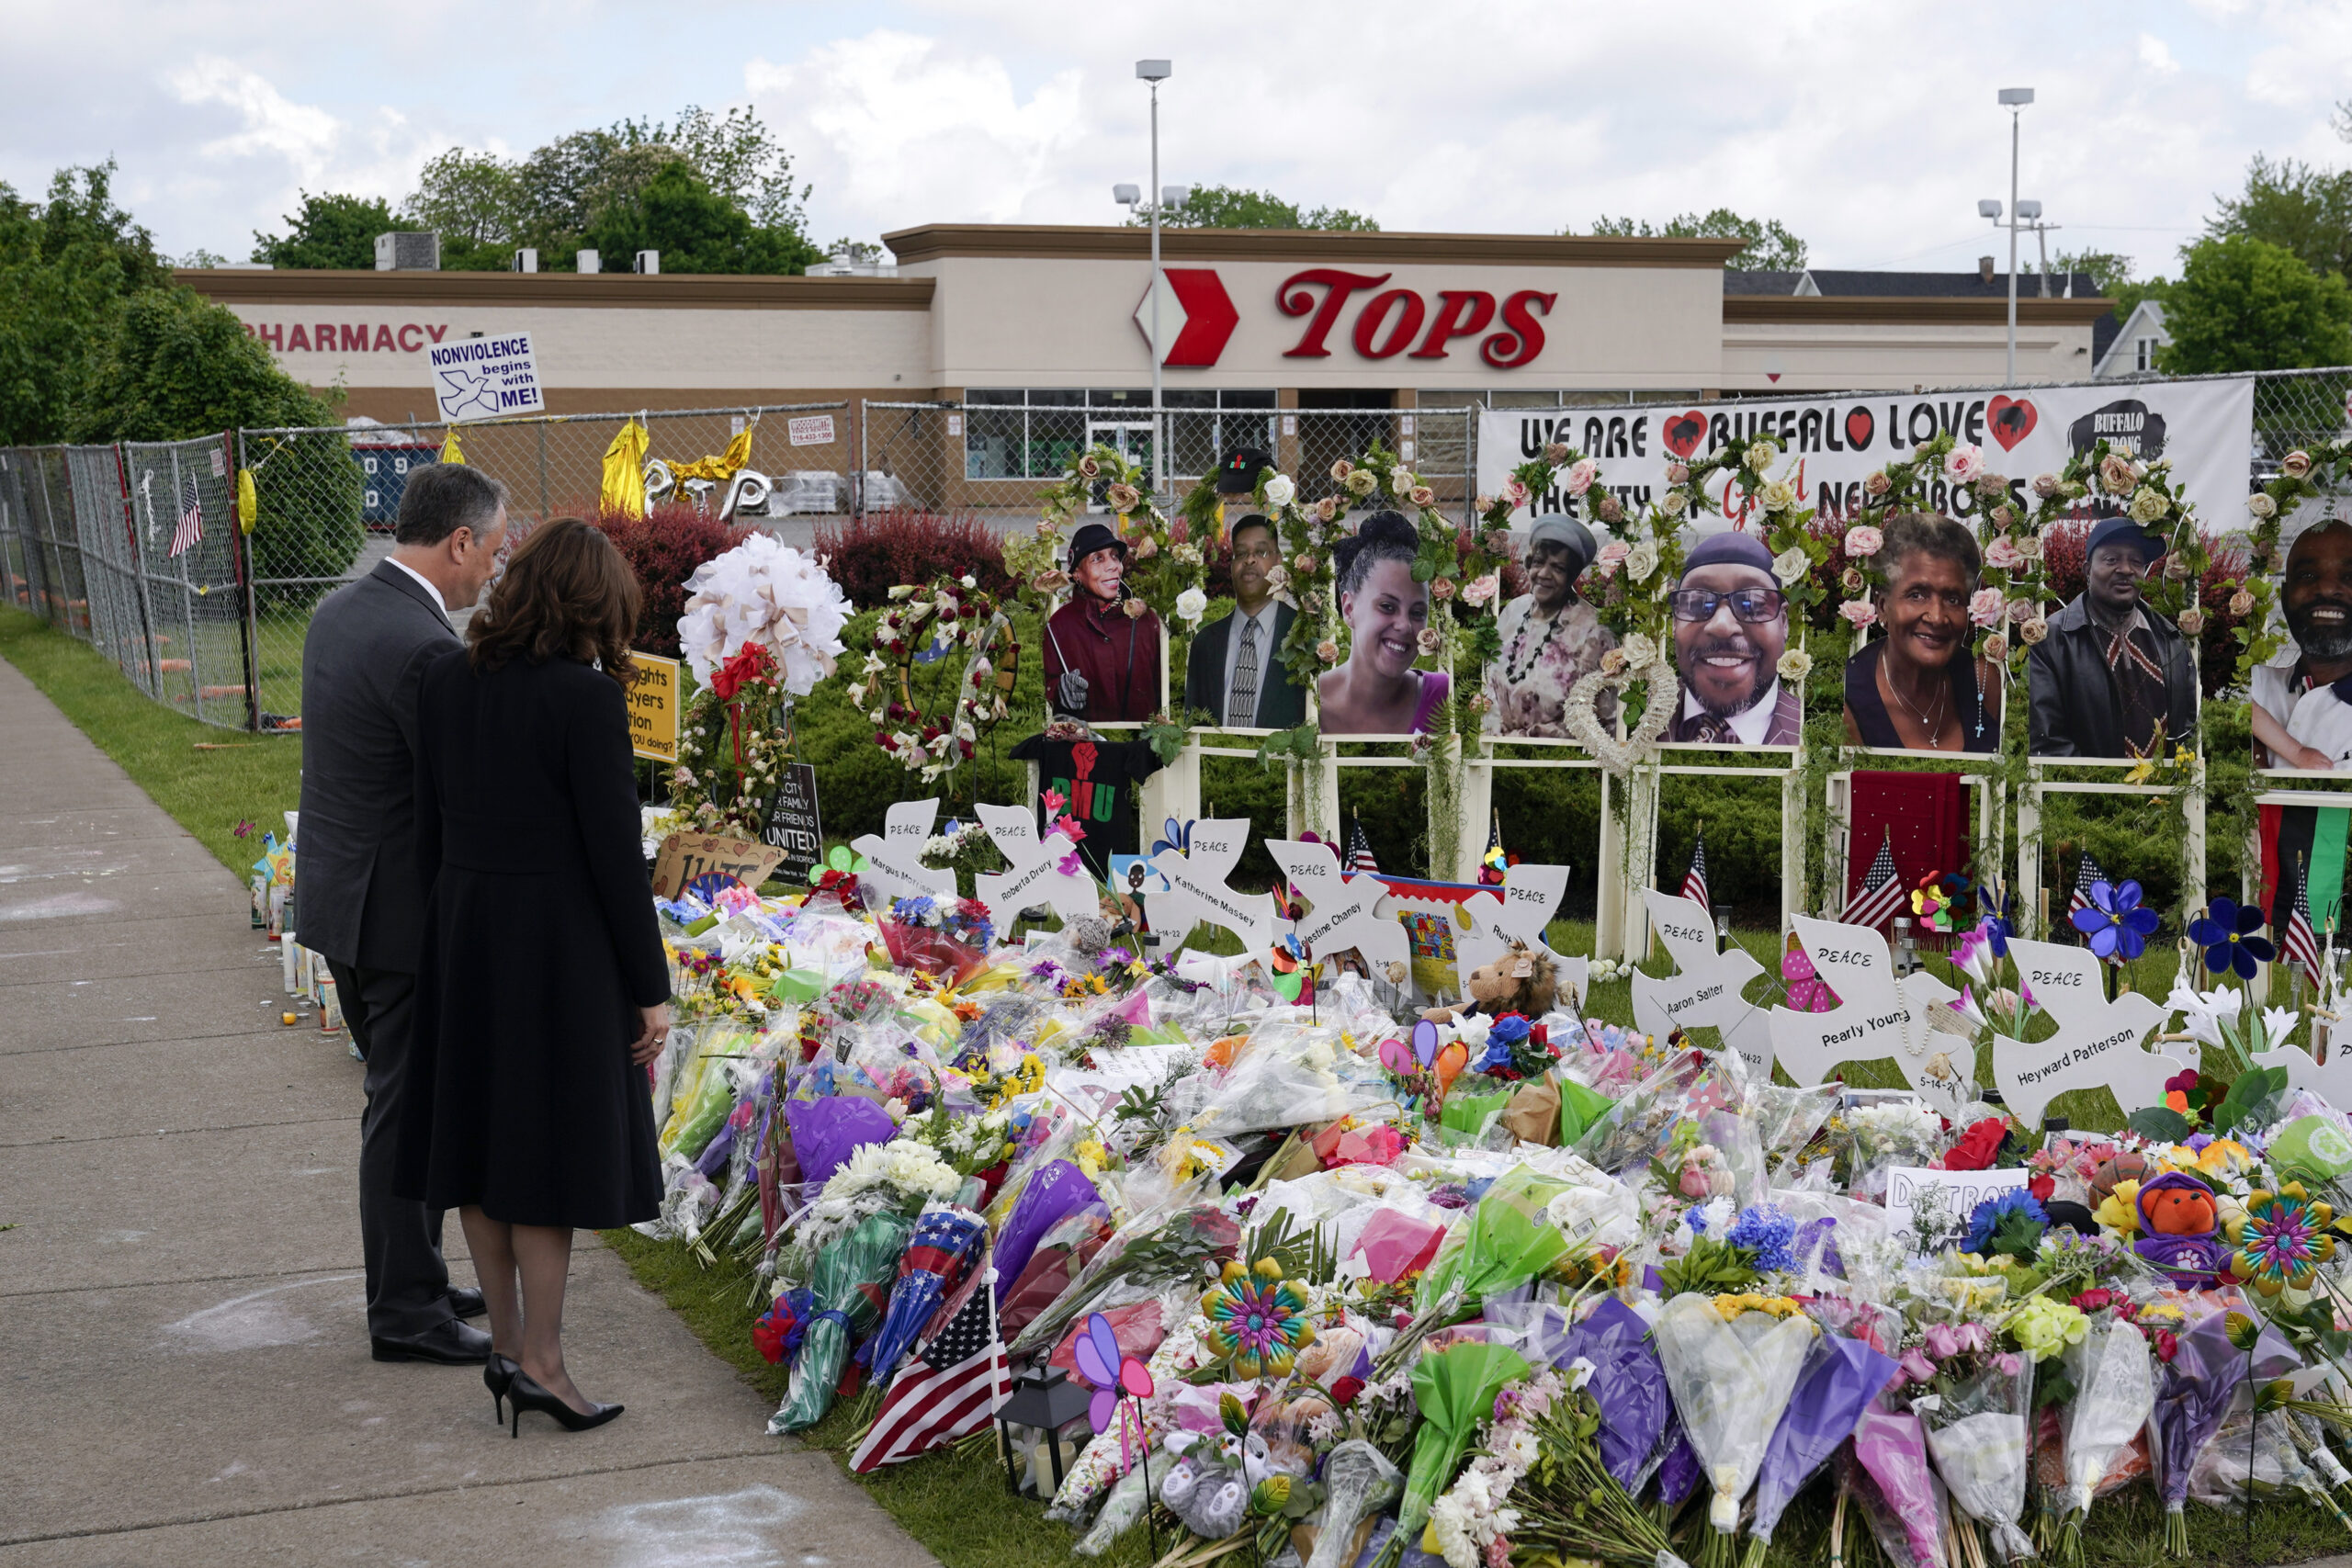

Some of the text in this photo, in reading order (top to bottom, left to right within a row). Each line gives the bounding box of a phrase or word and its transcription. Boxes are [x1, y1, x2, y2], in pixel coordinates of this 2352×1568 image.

[431, 337, 529, 366] NONVIOLENCE
[481, 361, 531, 375] begins
[501, 373, 534, 386] with
[501, 387, 538, 408] ME!
[1521, 400, 1984, 459] WE ARE BUFFALO LOVE
[2094, 412, 2144, 433] BUFFALO
[2096, 435, 2142, 455] RONG
[1818, 478, 2029, 519] NEIHBOS
[626, 690, 663, 710] ayers
[628, 710, 652, 731] tion
[647, 737, 673, 753] doing?
[785, 783, 803, 795] CITY
[1052, 777, 1115, 822] BMU
[766, 826, 817, 852] UNITED
[889, 825, 922, 835] PEACE
[995, 826, 1027, 837] PEACE
[1193, 840, 1228, 852] PEACE
[871, 855, 936, 896] Margus Morrison
[1290, 864, 1327, 876] PEACE
[1001, 859, 1052, 902] Roberta Drury
[1174, 874, 1255, 927] Katherine Massey
[1510, 887, 1545, 904] PEACE
[1155, 929, 1181, 938] 5-14-22
[1301, 901, 1362, 948] elestine Chaney
[1663, 924, 1704, 942] PEACE
[1375, 959, 1390, 969] 5-14
[1817, 947, 1872, 966] PEACE
[2031, 970, 2084, 987] PEACE
[1668, 984, 1724, 1015] Aaron Salter
[1822, 1024, 1864, 1047] Pearly
[1866, 1010, 1911, 1032] Young
[2018, 1028, 2134, 1086] Heyward Patterson
